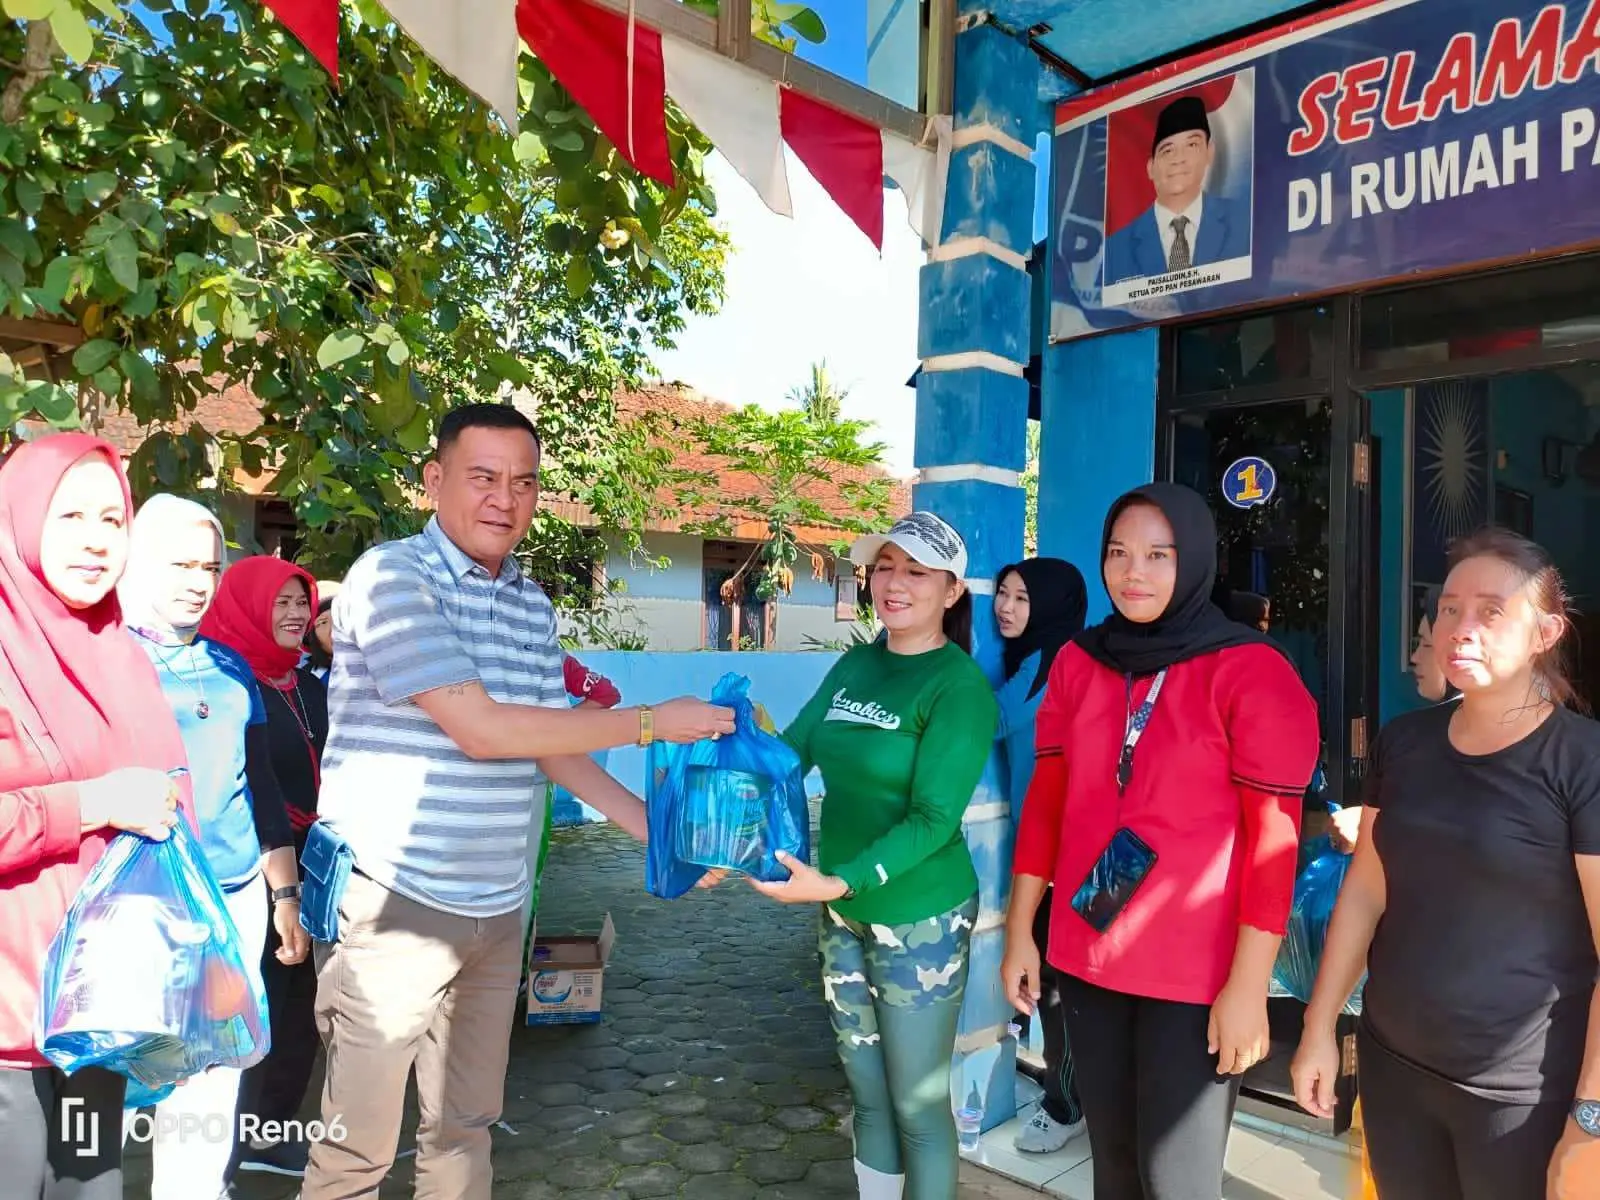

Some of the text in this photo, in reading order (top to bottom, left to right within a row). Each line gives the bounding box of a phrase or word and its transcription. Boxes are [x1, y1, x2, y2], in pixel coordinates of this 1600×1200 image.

[1288, 107, 1600, 232] DI RUMAH P
[1128, 273, 1221, 299] KETUA DPD PAN PESAWARAN
[1236, 464, 1264, 501] 1
